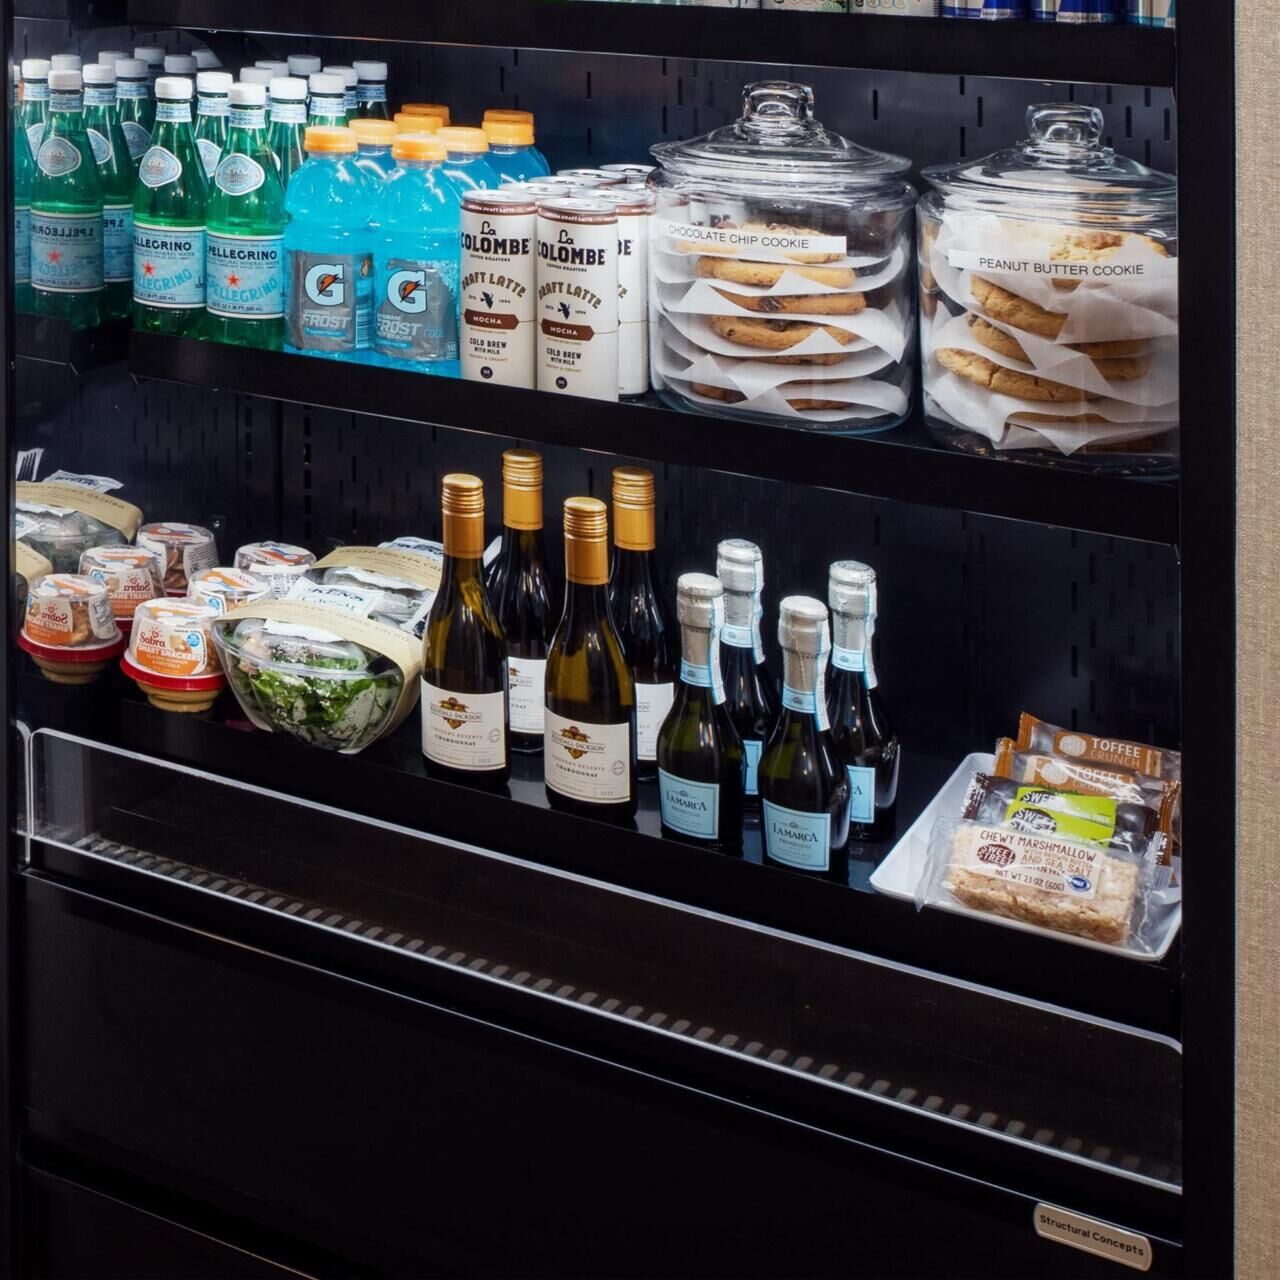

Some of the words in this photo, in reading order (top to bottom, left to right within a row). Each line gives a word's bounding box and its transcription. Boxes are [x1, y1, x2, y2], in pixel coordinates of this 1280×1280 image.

[481, 221, 496, 235] La
[669, 225, 726, 242] CHOCOLATE
[730, 234, 758, 245] CHIP
[761, 237, 809, 248] COOKIE
[461, 238, 530, 255] COLOMBE
[980, 258, 1030, 272] PEANUT
[1034, 264, 1088, 275] BUTTER
[1093, 264, 1144, 276] COOKIE
[462, 273, 485, 290] DRAFT
[490, 273, 526, 298] LATTE
[302, 315, 350, 329] FROST
[473, 316, 502, 325] MOCHA
[140, 633, 166, 647] Sabra
[435, 734, 476, 746] CHARDONNAY
[1092, 738, 1140, 757] TOFFEE
[1091, 750, 1140, 768] CRUNCH
[979, 845, 1014, 858] SWEET
[980, 830, 1014, 845] CHEWY
[1018, 837, 1096, 862] MARSHMALLOW
[978, 852, 1014, 865] STREET
[1021, 853, 1041, 865] AND
[1045, 858, 1063, 870] SEA
[1069, 863, 1091, 876] SALT
[1040, 1215, 1090, 1238] Structural
[1093, 1232, 1143, 1256] Concepts
